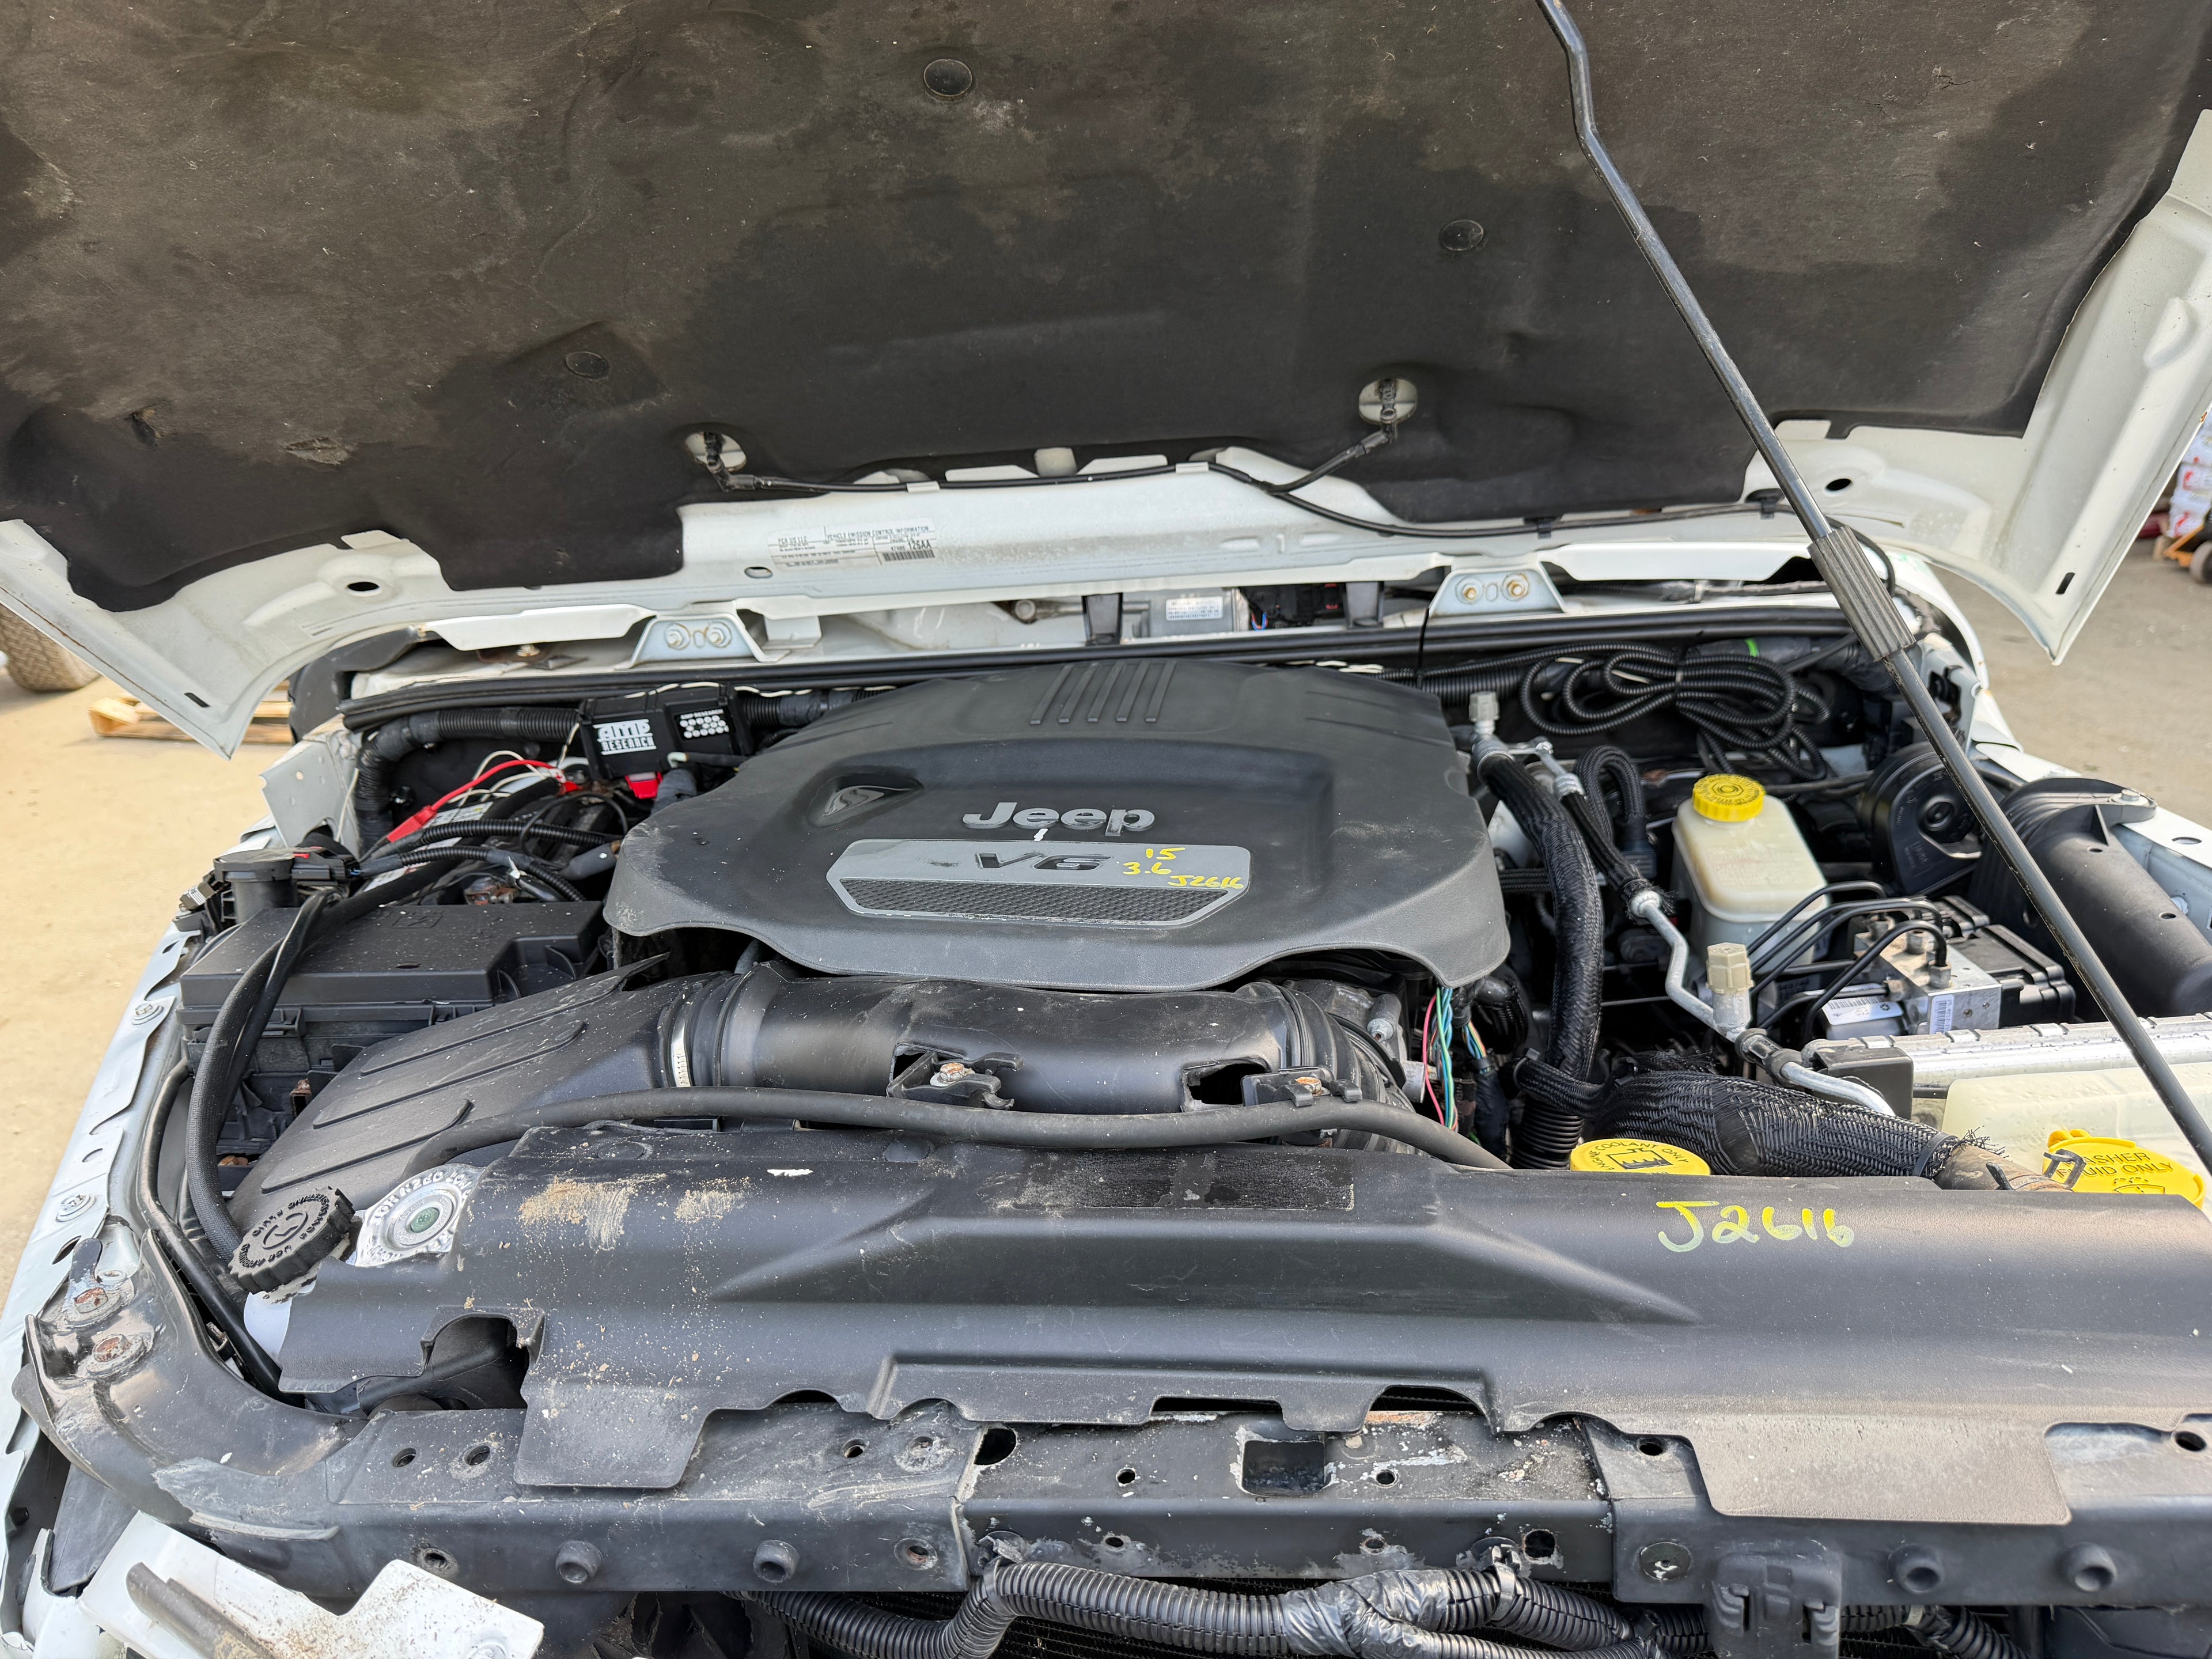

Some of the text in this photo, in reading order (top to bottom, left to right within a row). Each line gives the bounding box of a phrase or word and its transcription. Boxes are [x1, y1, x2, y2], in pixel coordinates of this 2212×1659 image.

[601, 736, 655, 751] RESEARCH
[963, 801, 1156, 836] Jeep
[976, 851, 1113, 871] V6
[1146, 847, 1185, 861] 15
[1122, 861, 1172, 876] 3.6
[1595, 1142, 1658, 1151] COOLANT
[1661, 1148, 1689, 1164] ONLY
[2065, 1152, 2151, 1166] ASHER
[2056, 1162, 2174, 1179] FUID ONLY
[1656, 1200, 1855, 1253] J2616
